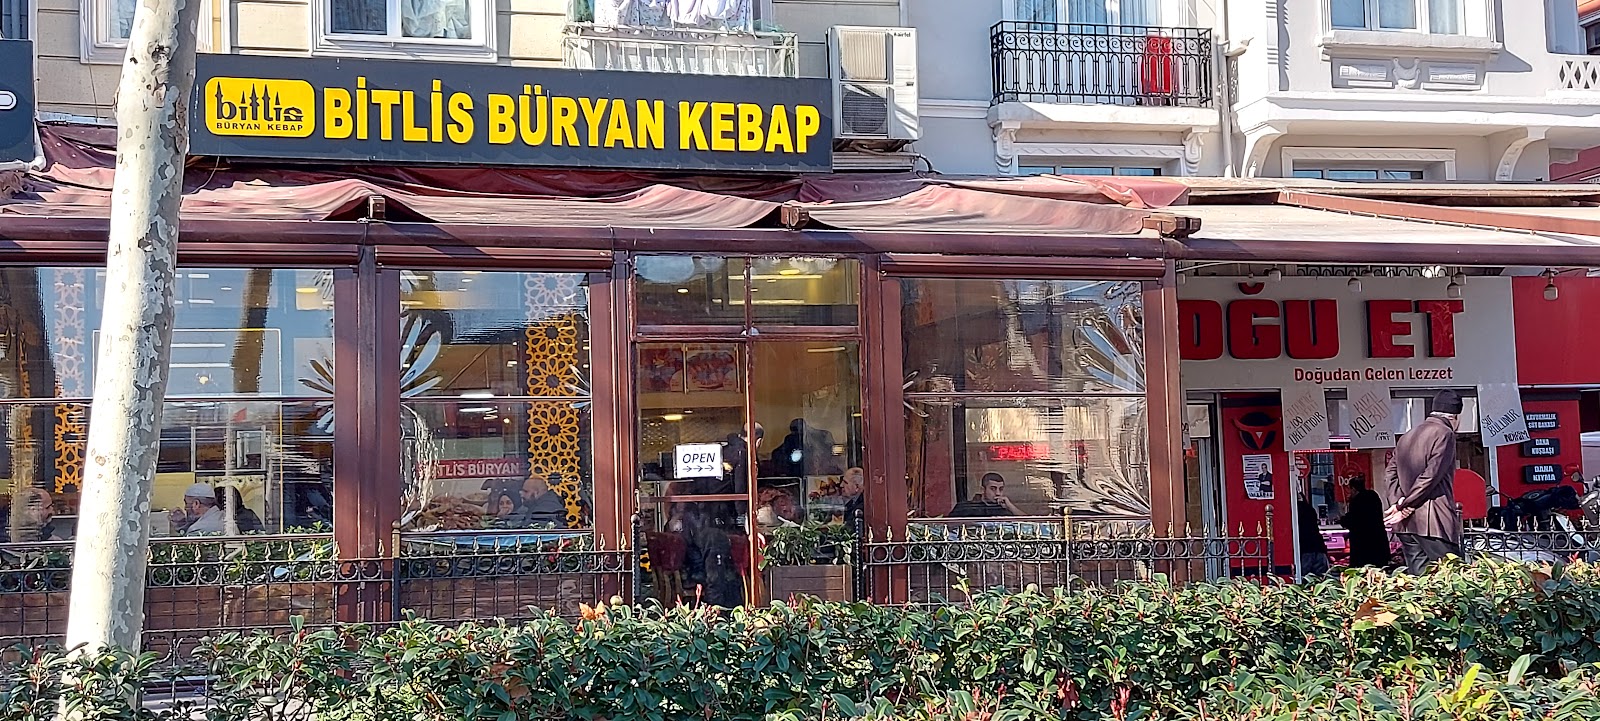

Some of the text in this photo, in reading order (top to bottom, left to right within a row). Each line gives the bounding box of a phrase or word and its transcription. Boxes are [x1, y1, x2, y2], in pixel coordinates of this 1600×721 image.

[323, 76, 821, 153] BİTLİS BÜRYAN KEBAP
[216, 121, 303, 132] BÜRYAN KEBAP
[1177, 281, 1464, 360] OĞU ET
[1294, 366, 1453, 384] Doğudan Gelen Lezzet
[682, 453, 716, 464] OPEN
[468, 460, 520, 476] BÜRYAN
[1534, 465, 1553, 473] DANA
[1532, 473, 1556, 481] KIYMA
